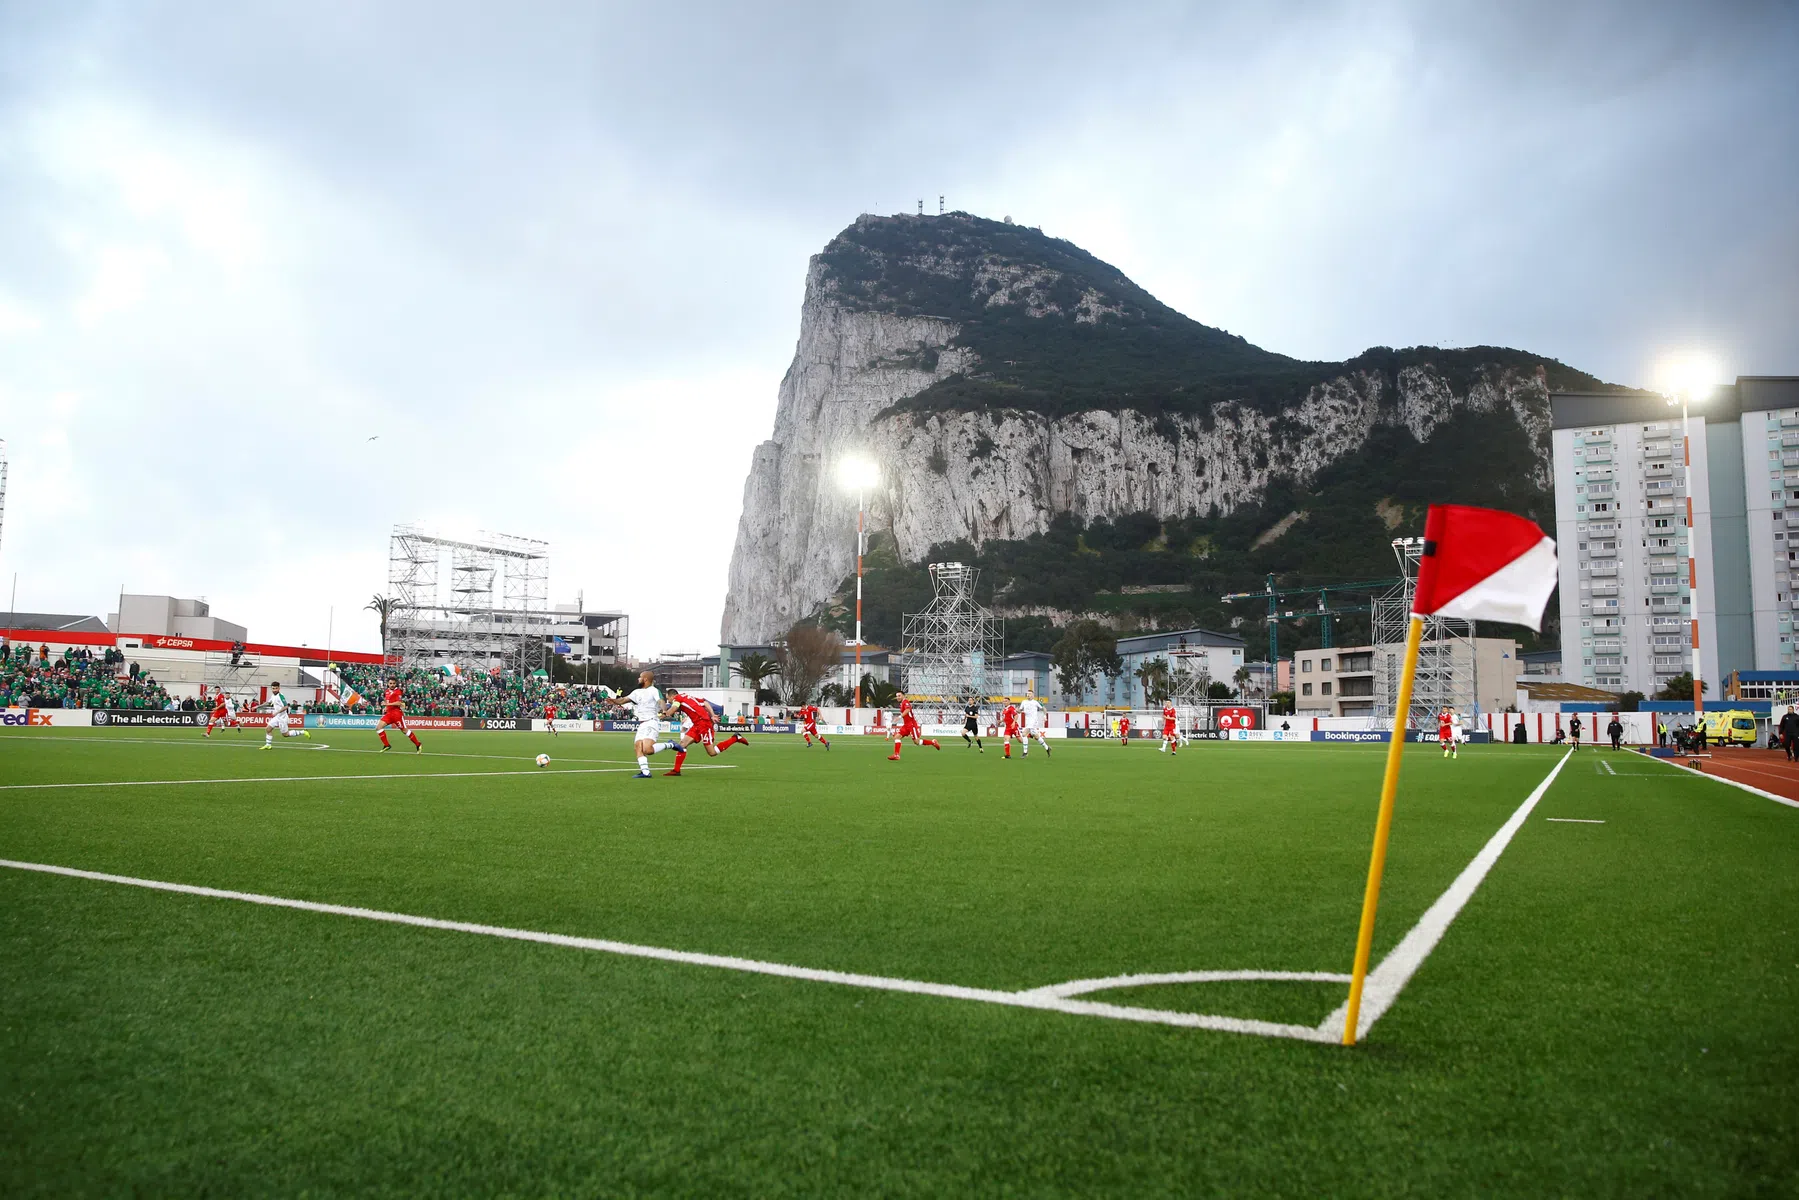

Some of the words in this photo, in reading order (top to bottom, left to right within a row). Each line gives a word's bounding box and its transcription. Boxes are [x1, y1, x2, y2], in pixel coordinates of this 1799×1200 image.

[167, 639, 193, 647] CEPSA
[111, 715, 129, 723] The
[131, 715, 180, 724] all-electric
[182, 716, 194, 724] ID.
[487, 719, 516, 729] SOCAR
[1325, 732, 1381, 741] Booking.com
